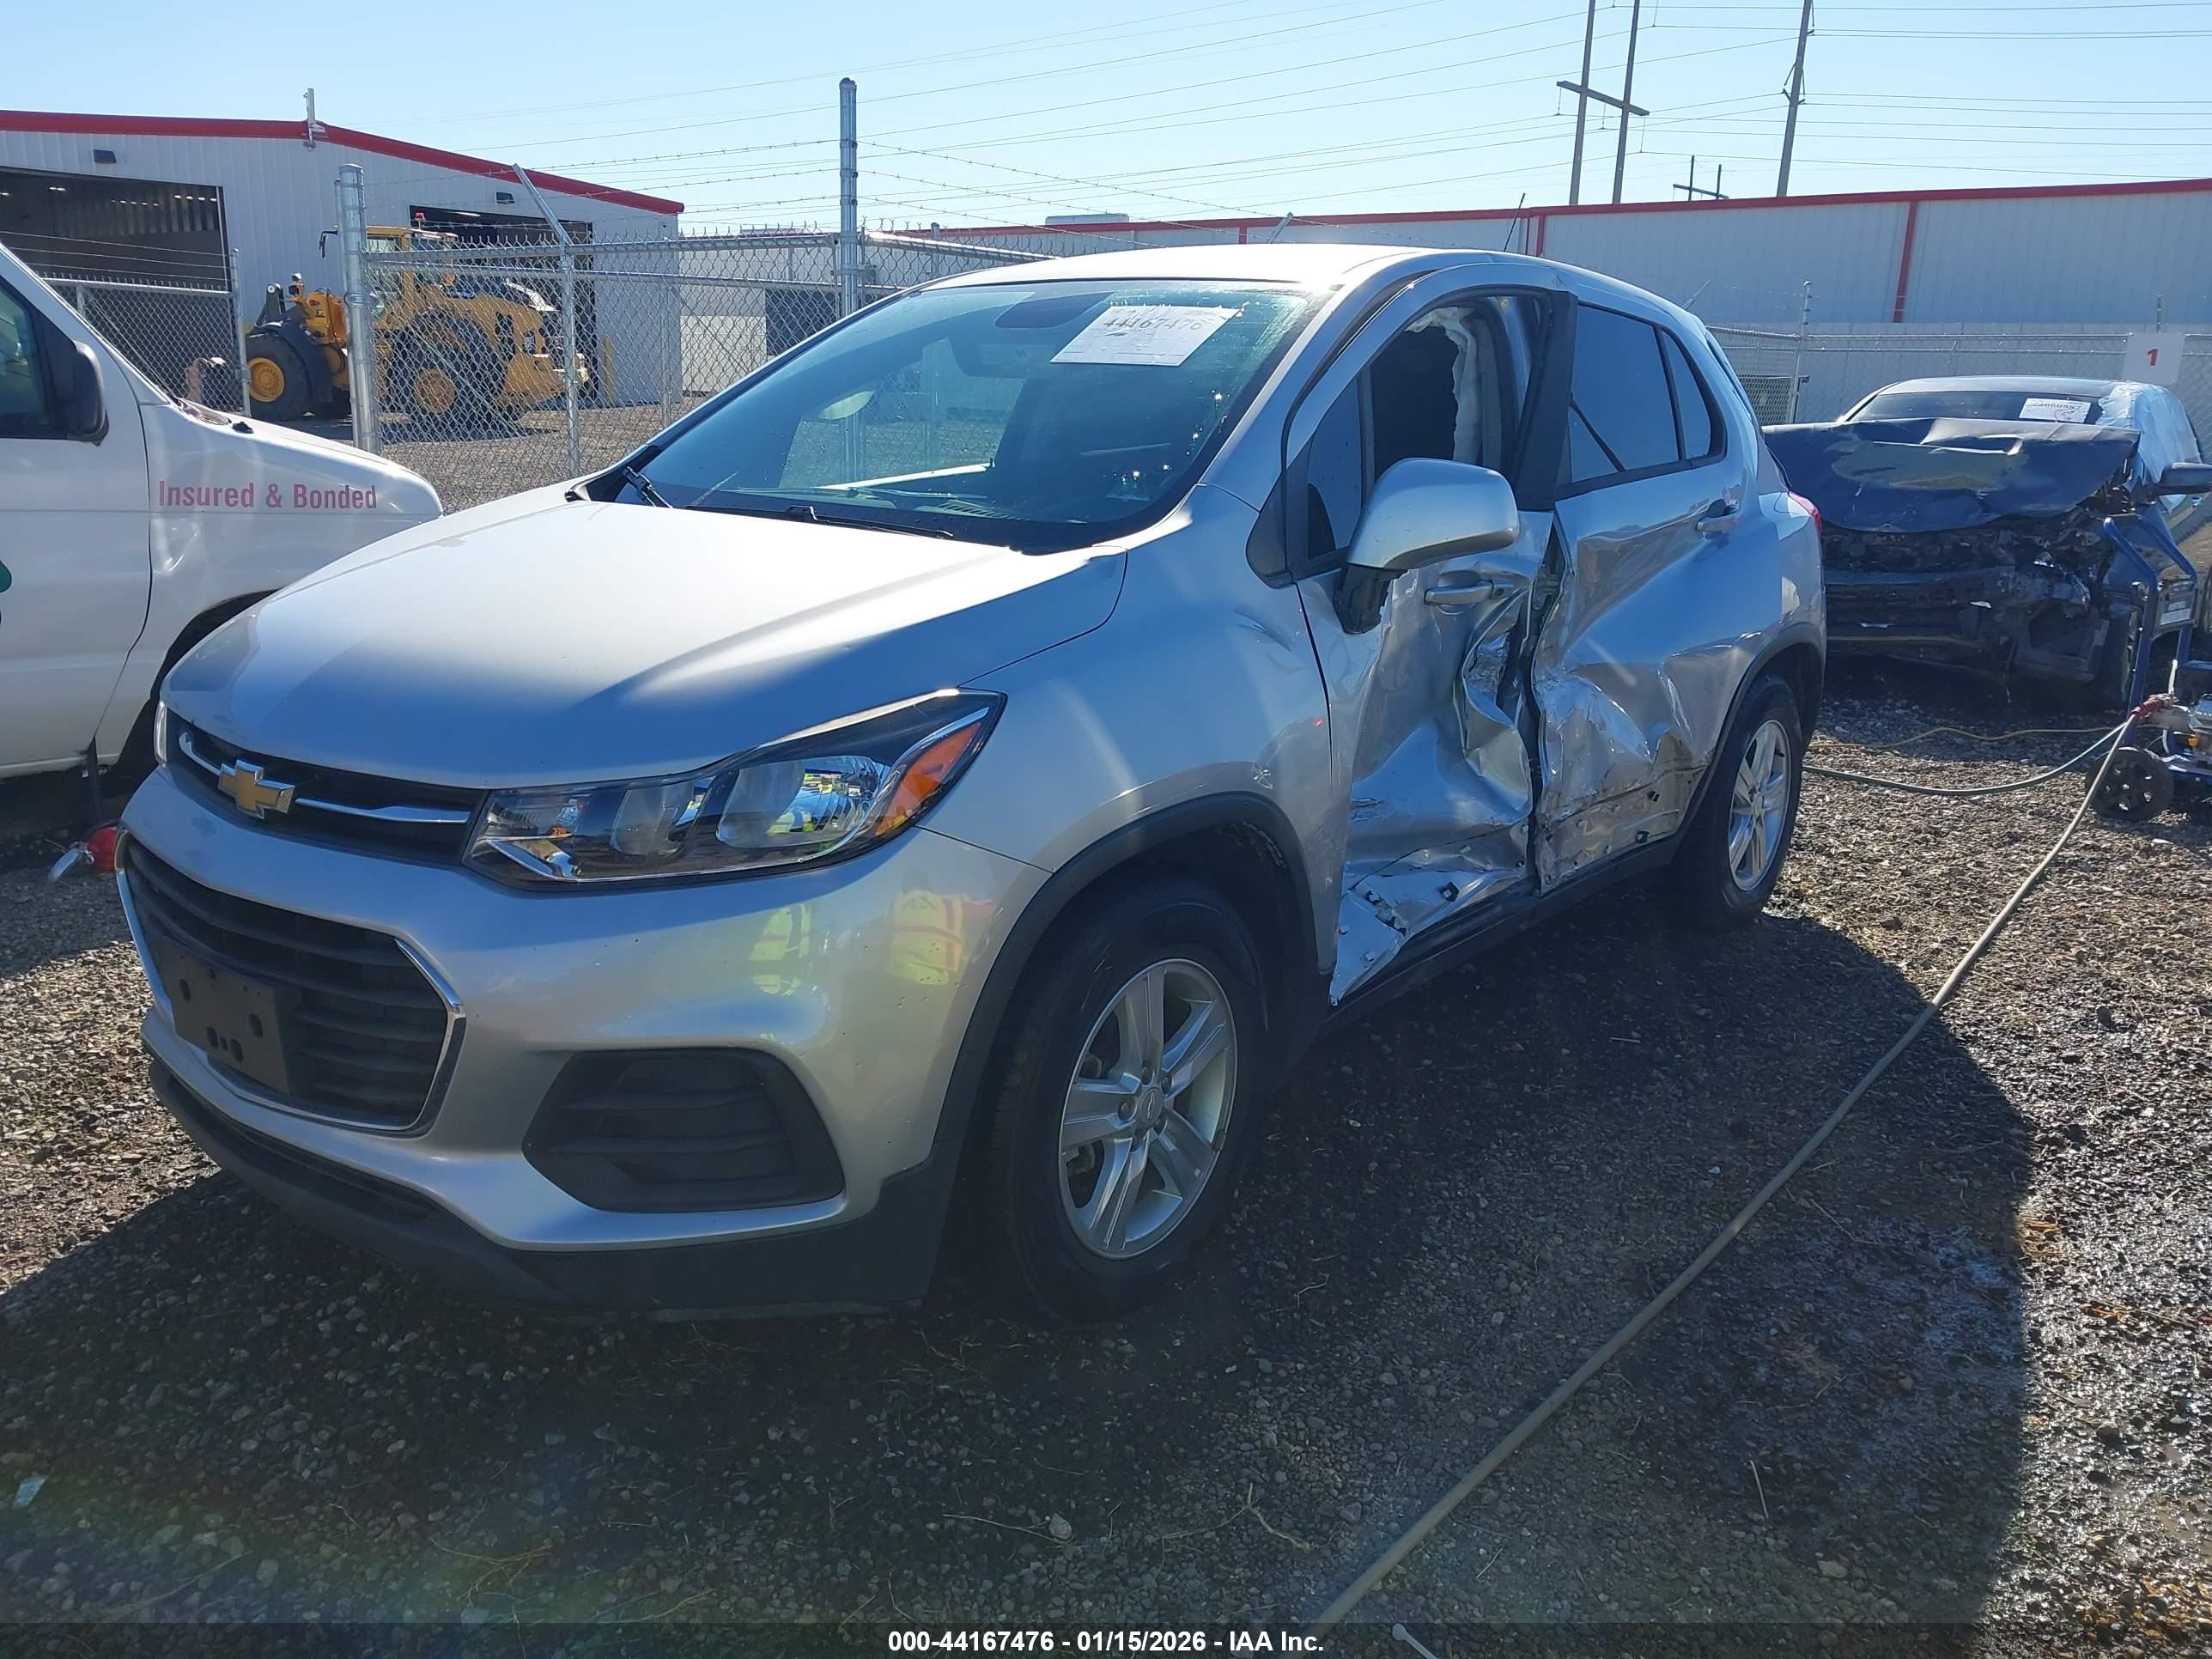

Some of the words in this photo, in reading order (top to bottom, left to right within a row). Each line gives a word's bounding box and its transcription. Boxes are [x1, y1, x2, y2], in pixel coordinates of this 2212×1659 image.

[2146, 348, 2159, 367] 1
[159, 480, 254, 508] Insured
[265, 483, 283, 508] &
[293, 483, 378, 509] Bonded
